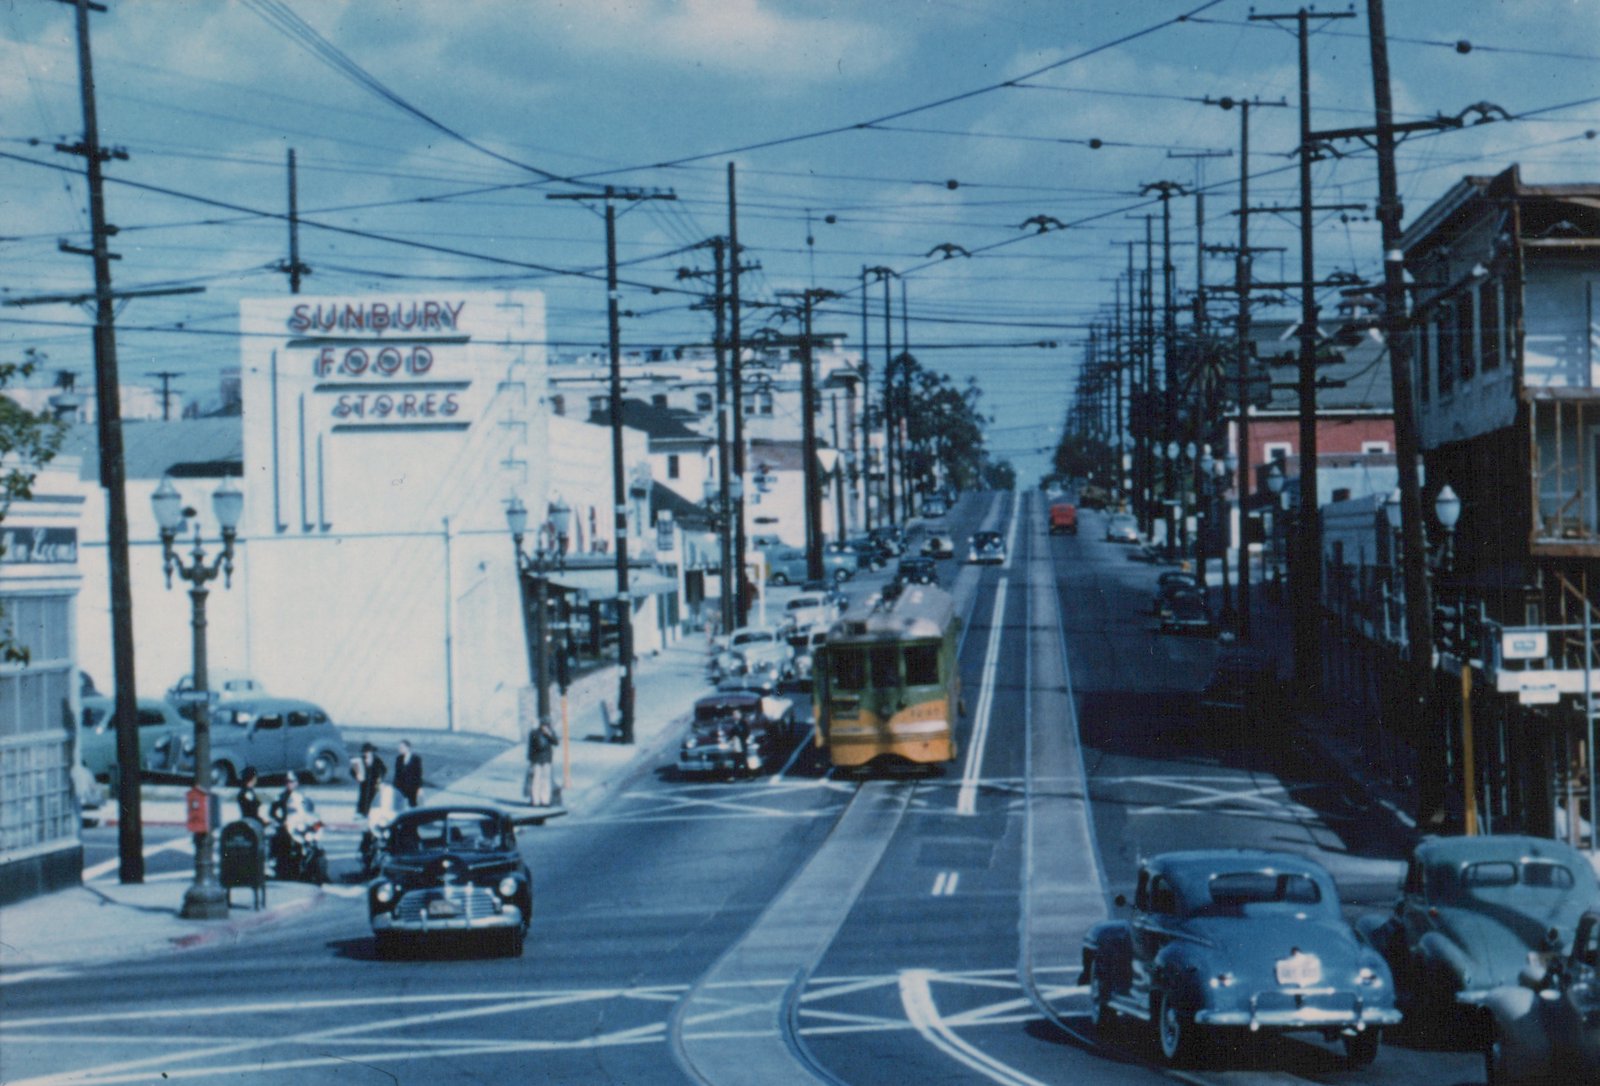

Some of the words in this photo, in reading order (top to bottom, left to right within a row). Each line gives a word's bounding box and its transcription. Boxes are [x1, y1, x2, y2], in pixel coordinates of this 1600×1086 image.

[288, 300, 465, 332] SUNBURY
[314, 345, 433, 376] FOOD
[333, 393, 460, 417] STORES
